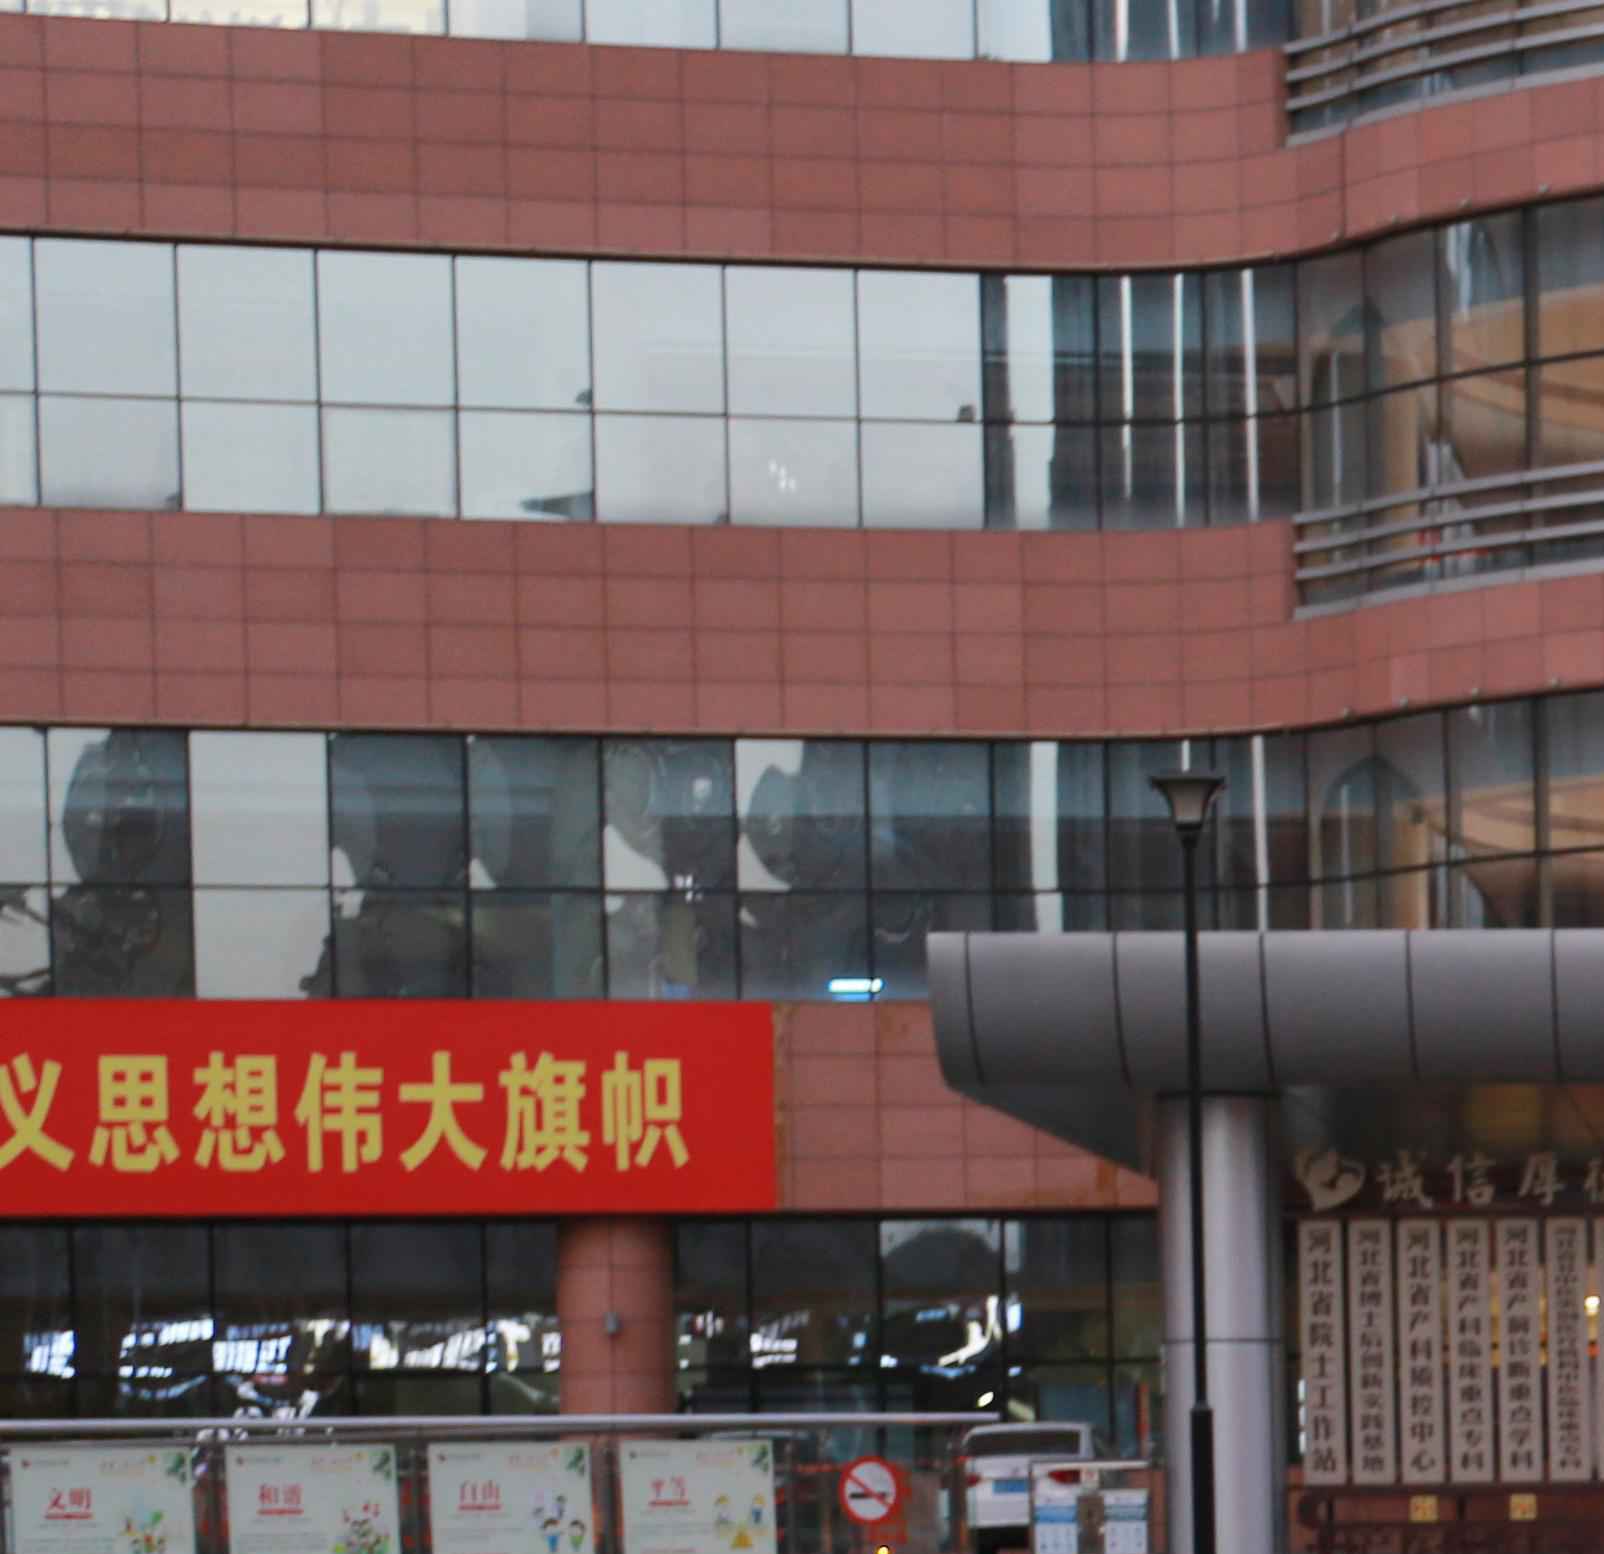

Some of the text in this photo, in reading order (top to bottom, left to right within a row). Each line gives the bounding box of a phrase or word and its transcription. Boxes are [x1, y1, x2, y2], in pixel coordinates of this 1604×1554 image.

[0, 1050, 690, 1174] 义思想伟大旗帜
[46, 1486, 93, 1512] 文明
[257, 1483, 304, 1507] 和谐
